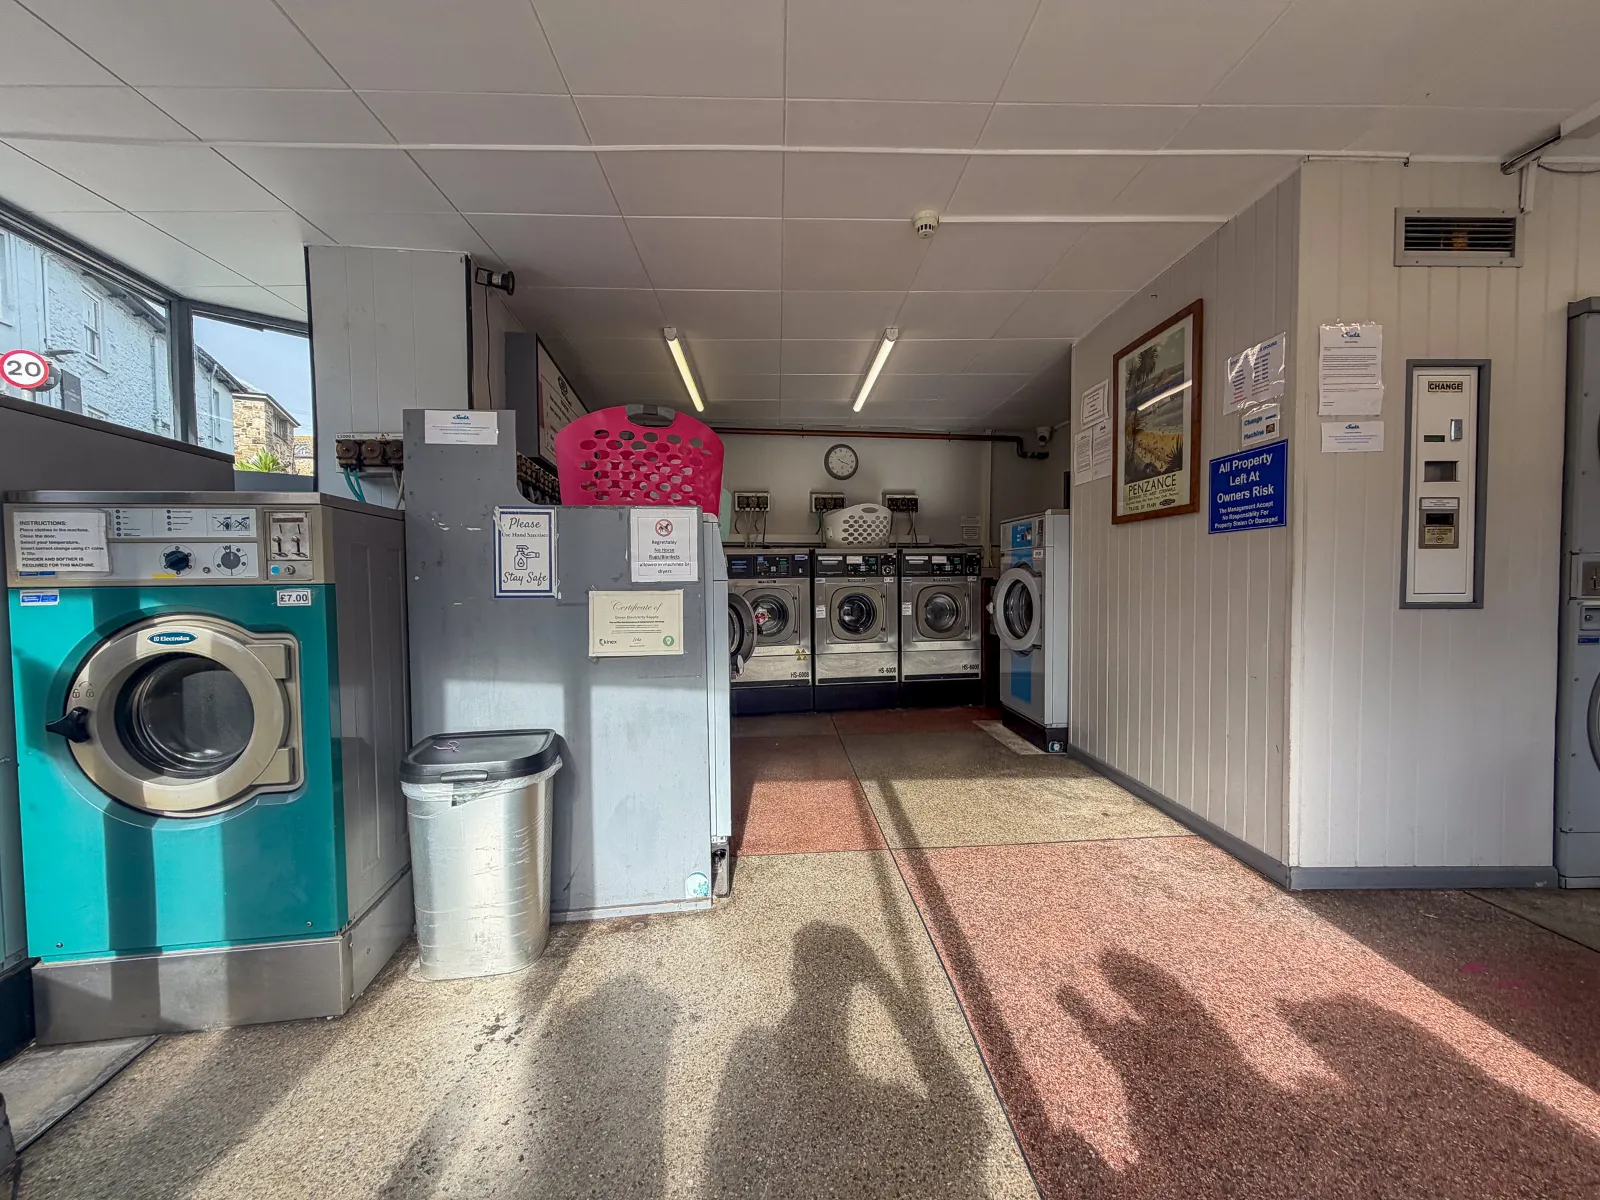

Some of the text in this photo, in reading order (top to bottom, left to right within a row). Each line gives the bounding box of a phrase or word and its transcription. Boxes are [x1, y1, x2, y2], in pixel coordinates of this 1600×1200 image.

[6, 360, 42, 377] 20
[1243, 416, 1263, 427] Change
[1243, 429, 1265, 441] Machine
[1219, 453, 1273, 474] All Property
[1128, 473, 1177, 497] PENZANCE
[1229, 471, 1260, 486] Left At
[1216, 484, 1274, 503] Owners Risk
[1227, 503, 1256, 513] Management
[1256, 500, 1274, 509] Accept
[1260, 509, 1270, 517] For
[509, 517, 542, 530] Please
[1214, 521, 1233, 529] Property
[1248, 517, 1255, 525] Or
[1254, 515, 1279, 525] Damaged
[503, 571, 549, 587] Stay Safe
[279, 593, 308, 602] £7.00
[611, 600, 663, 613] Certificate of
